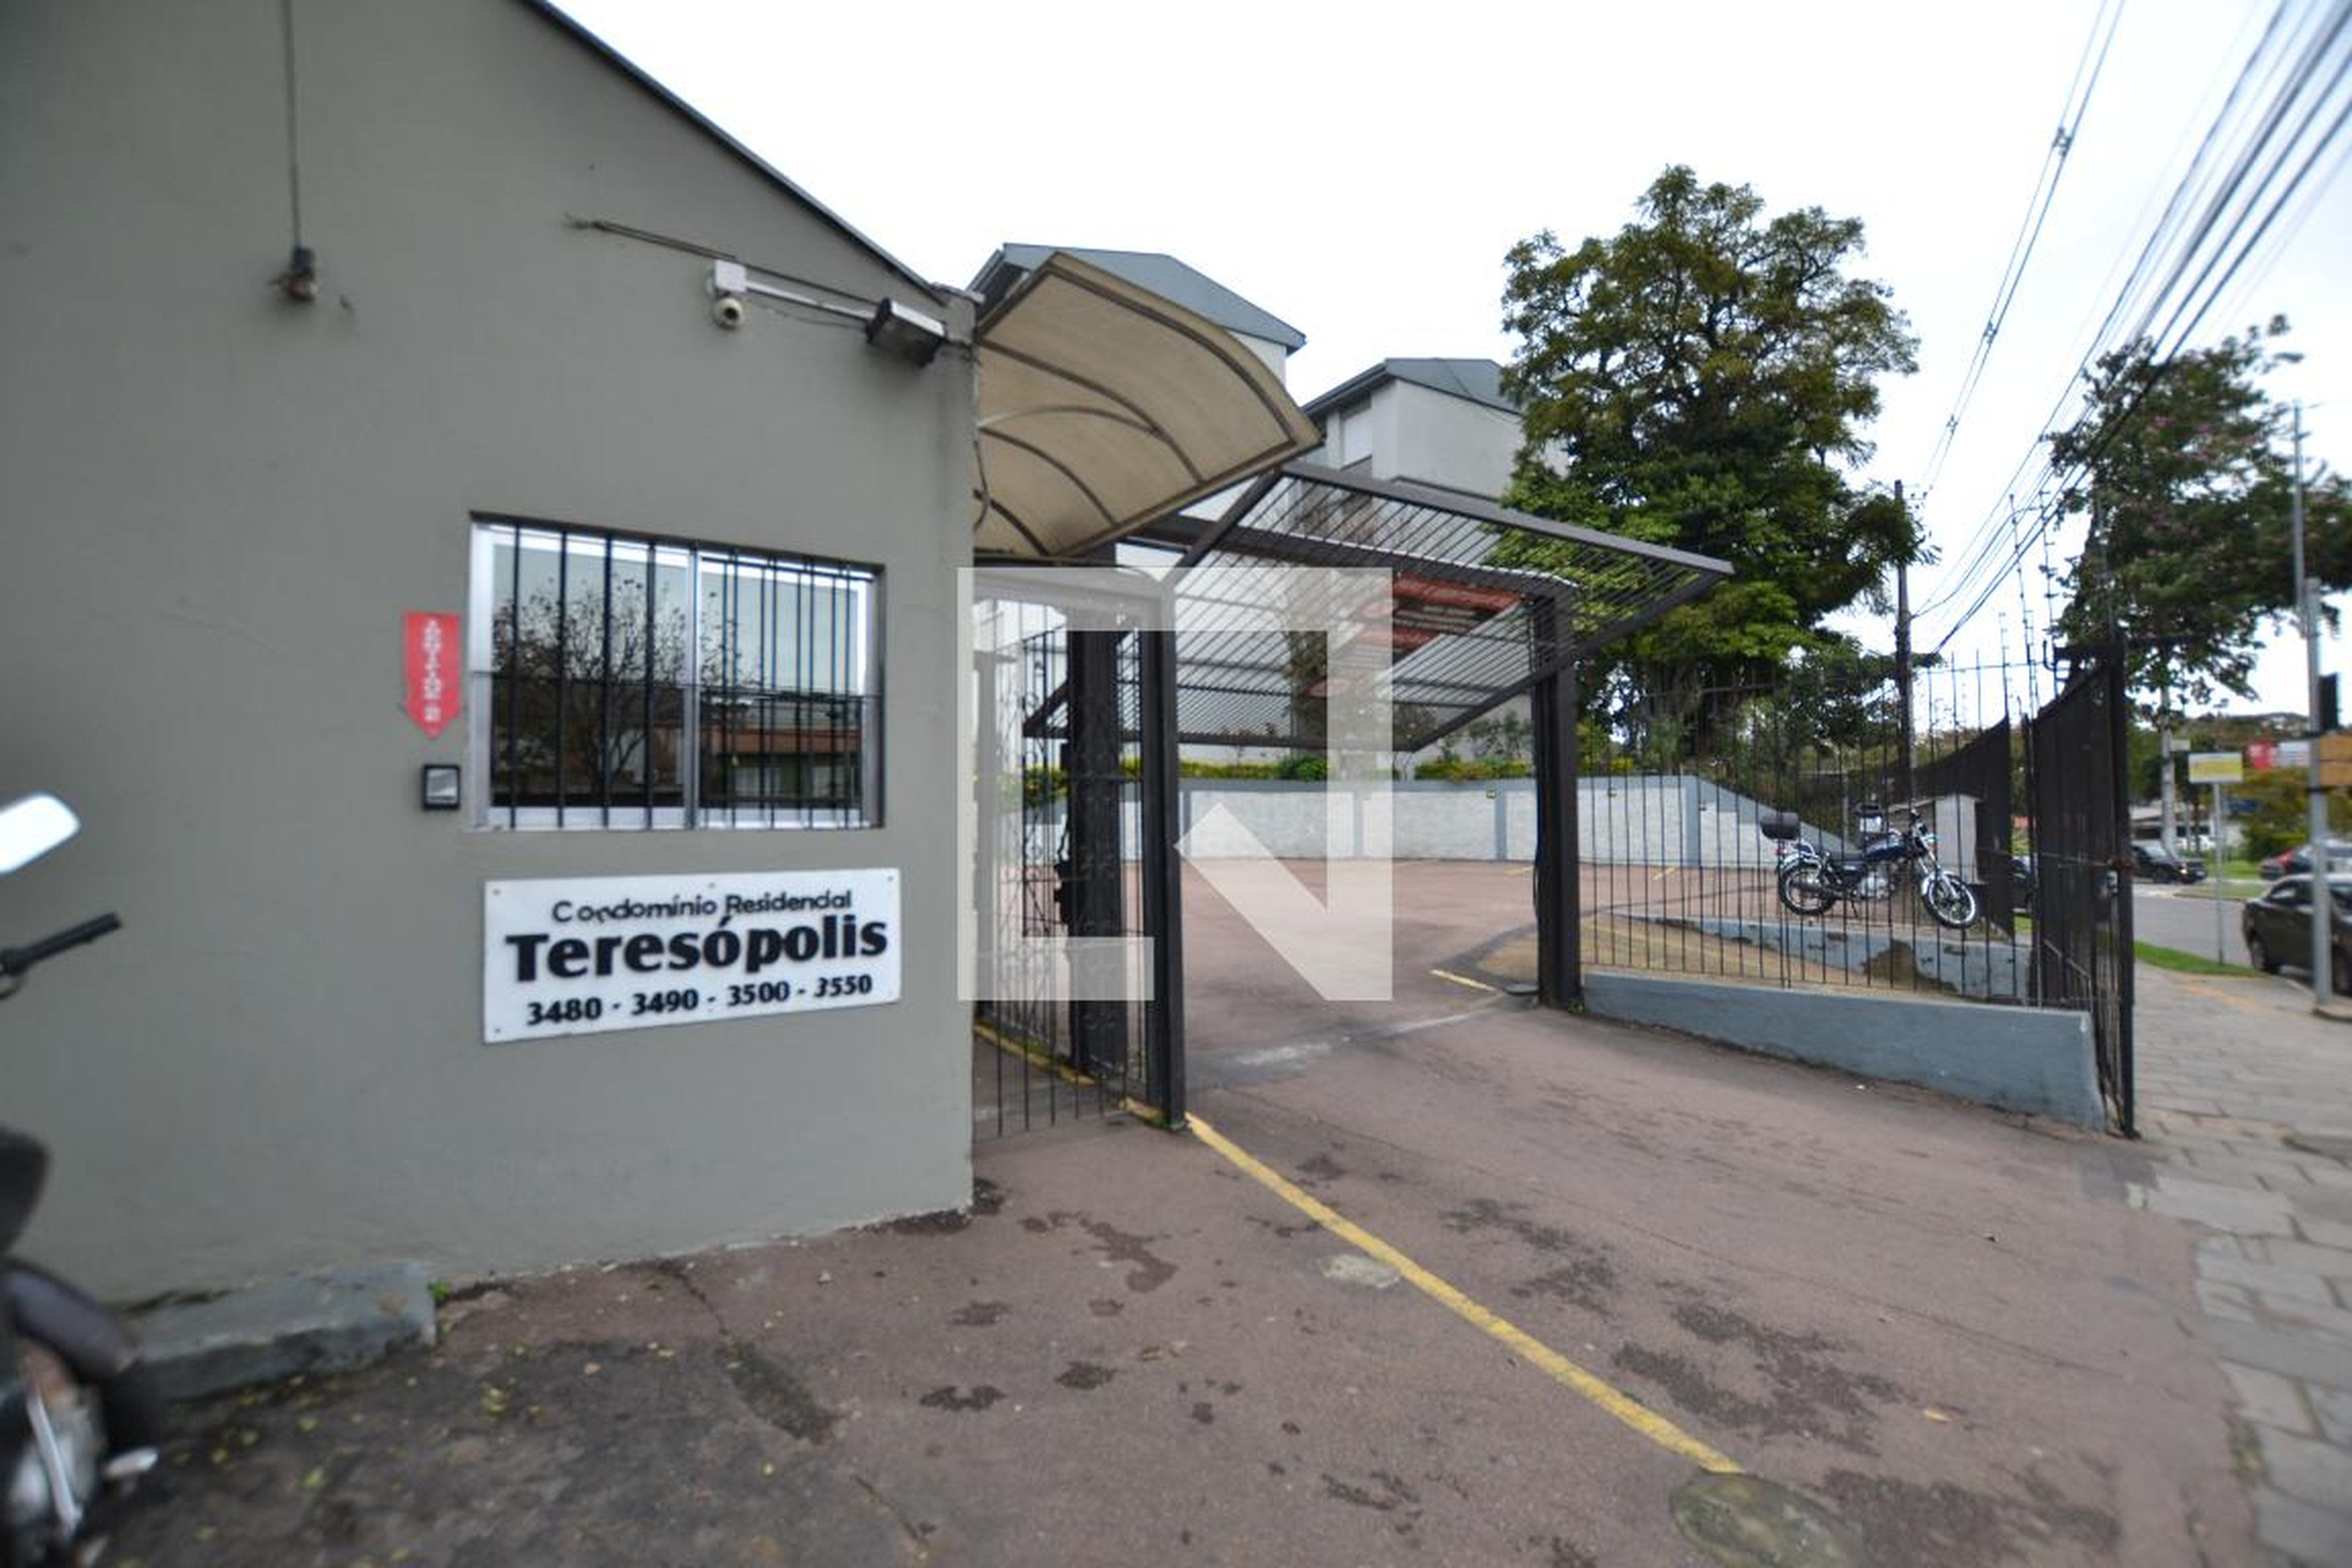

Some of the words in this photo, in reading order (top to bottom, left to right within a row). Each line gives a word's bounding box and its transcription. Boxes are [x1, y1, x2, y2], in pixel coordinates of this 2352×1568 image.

[504, 914, 888, 984] Teresópolis
[527, 997, 603, 1027] 3480
[631, 988, 699, 1016] 3490
[726, 981, 791, 1007] 3500
[813, 974, 873, 998] 3550
